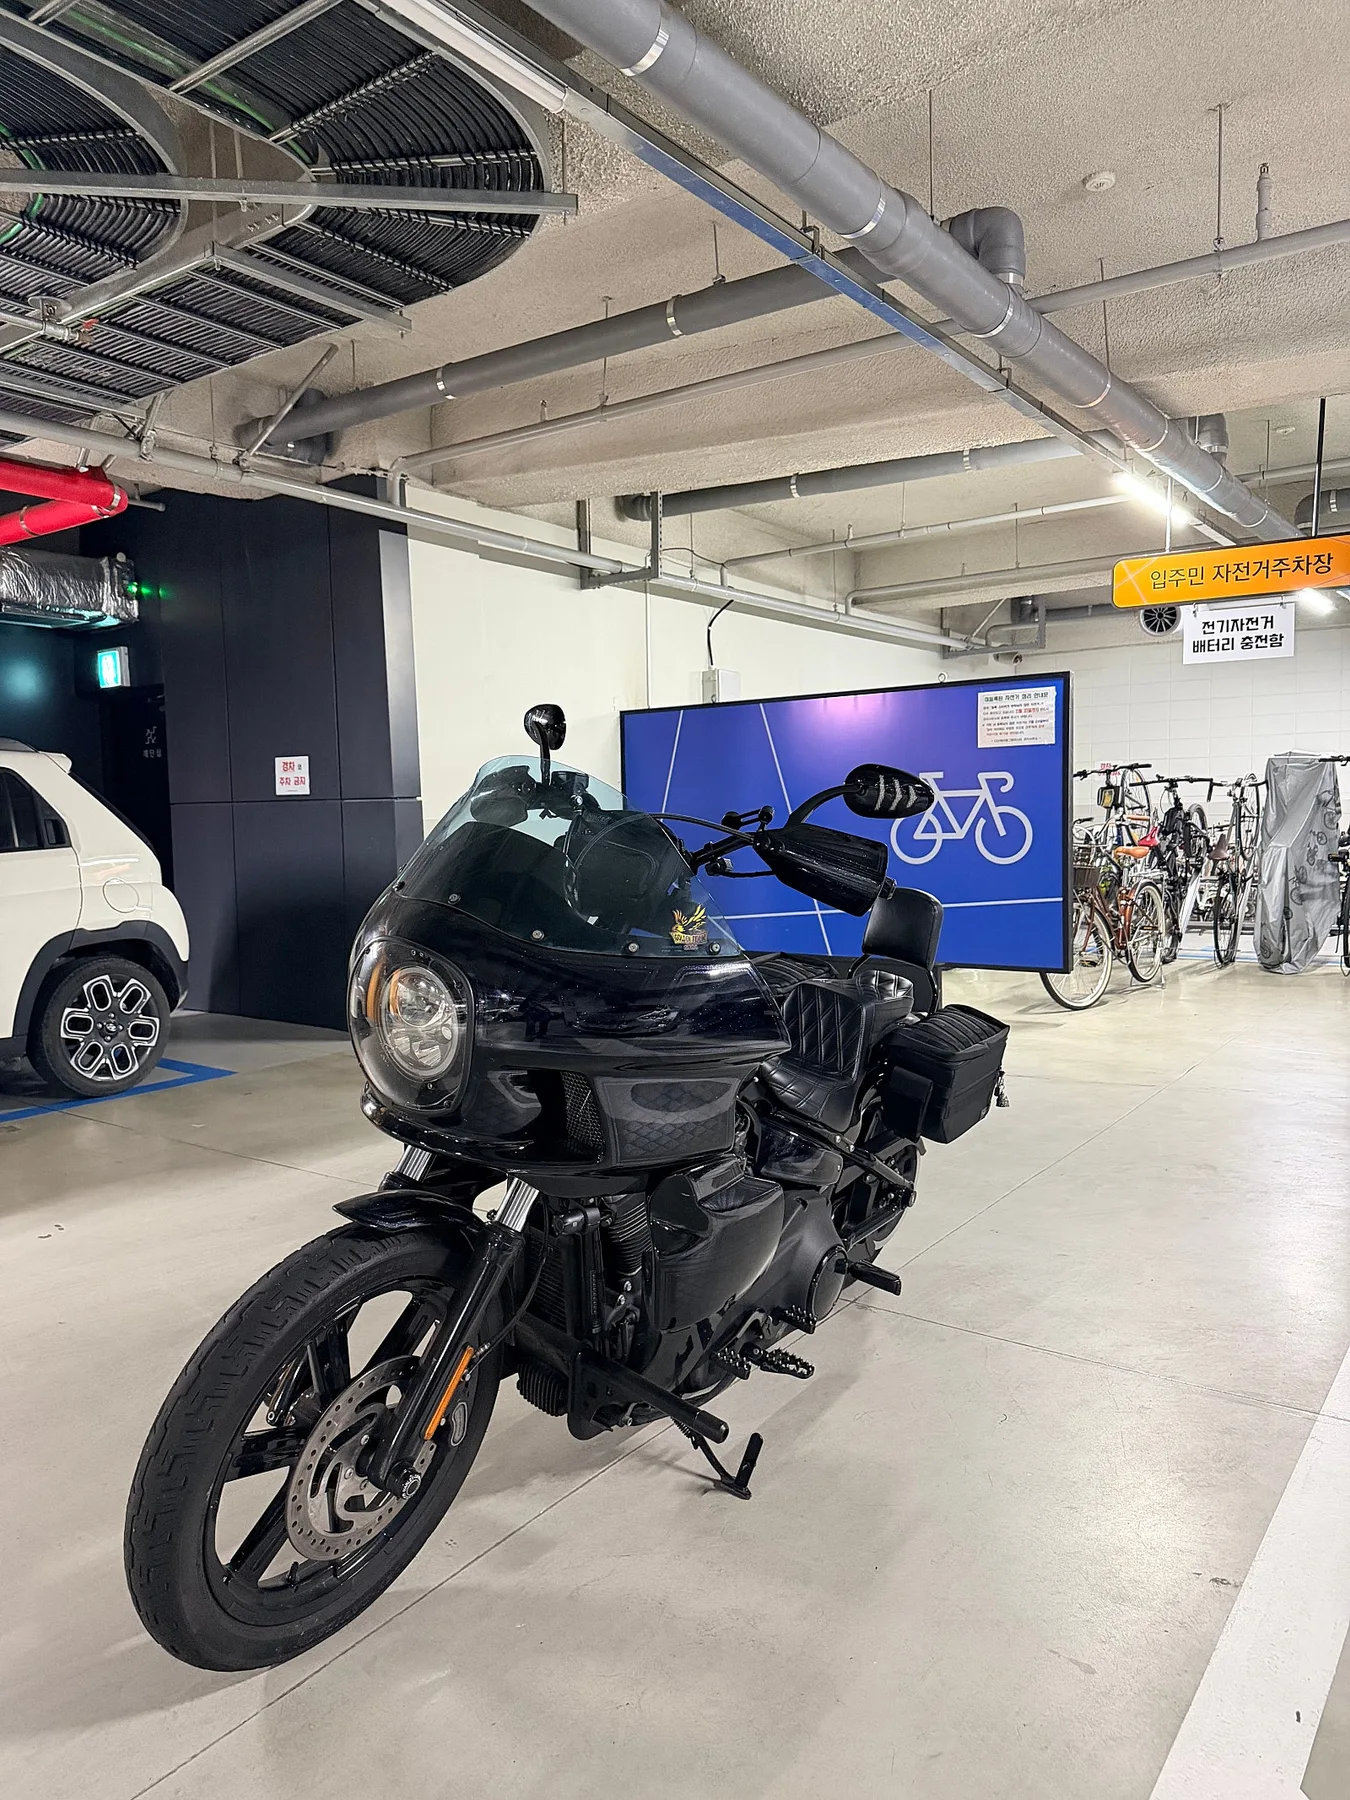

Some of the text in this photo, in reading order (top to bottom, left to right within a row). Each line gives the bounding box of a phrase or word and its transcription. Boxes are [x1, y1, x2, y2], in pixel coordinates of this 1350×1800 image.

[1150, 553, 1334, 589] 입주민 자전거주차장
[1201, 616, 1274, 635] 전기자전거
[1192, 633, 1285, 653] 배터리 충전함
[1033, 691, 1049, 699] 안내문
[282, 760, 295, 772] 경차
[279, 776, 306, 786] 주차 금지
